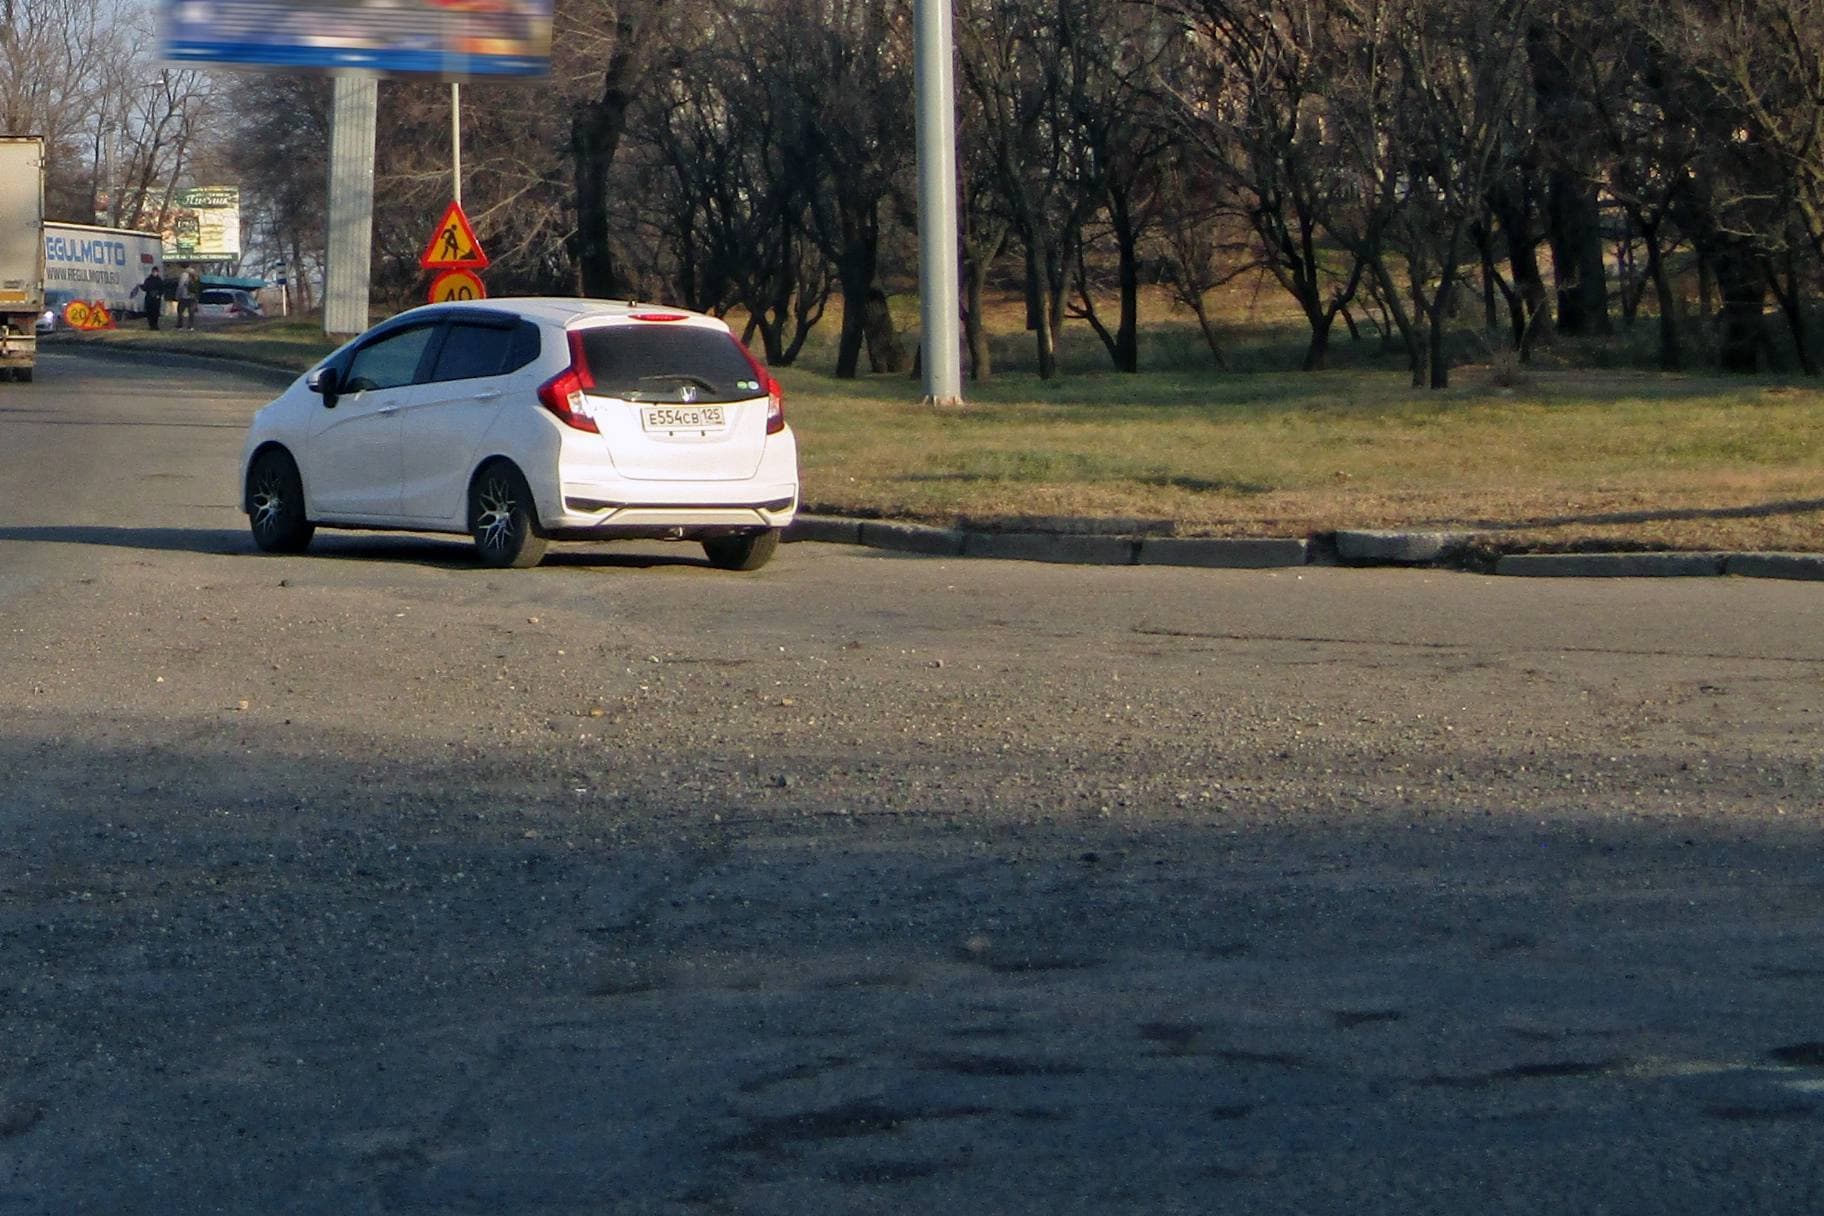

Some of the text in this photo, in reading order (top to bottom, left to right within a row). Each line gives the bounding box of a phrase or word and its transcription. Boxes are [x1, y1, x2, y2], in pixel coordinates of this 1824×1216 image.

[46, 236, 126, 266] EGULMOTO
[649, 408, 721, 425] Е554СВ 125
